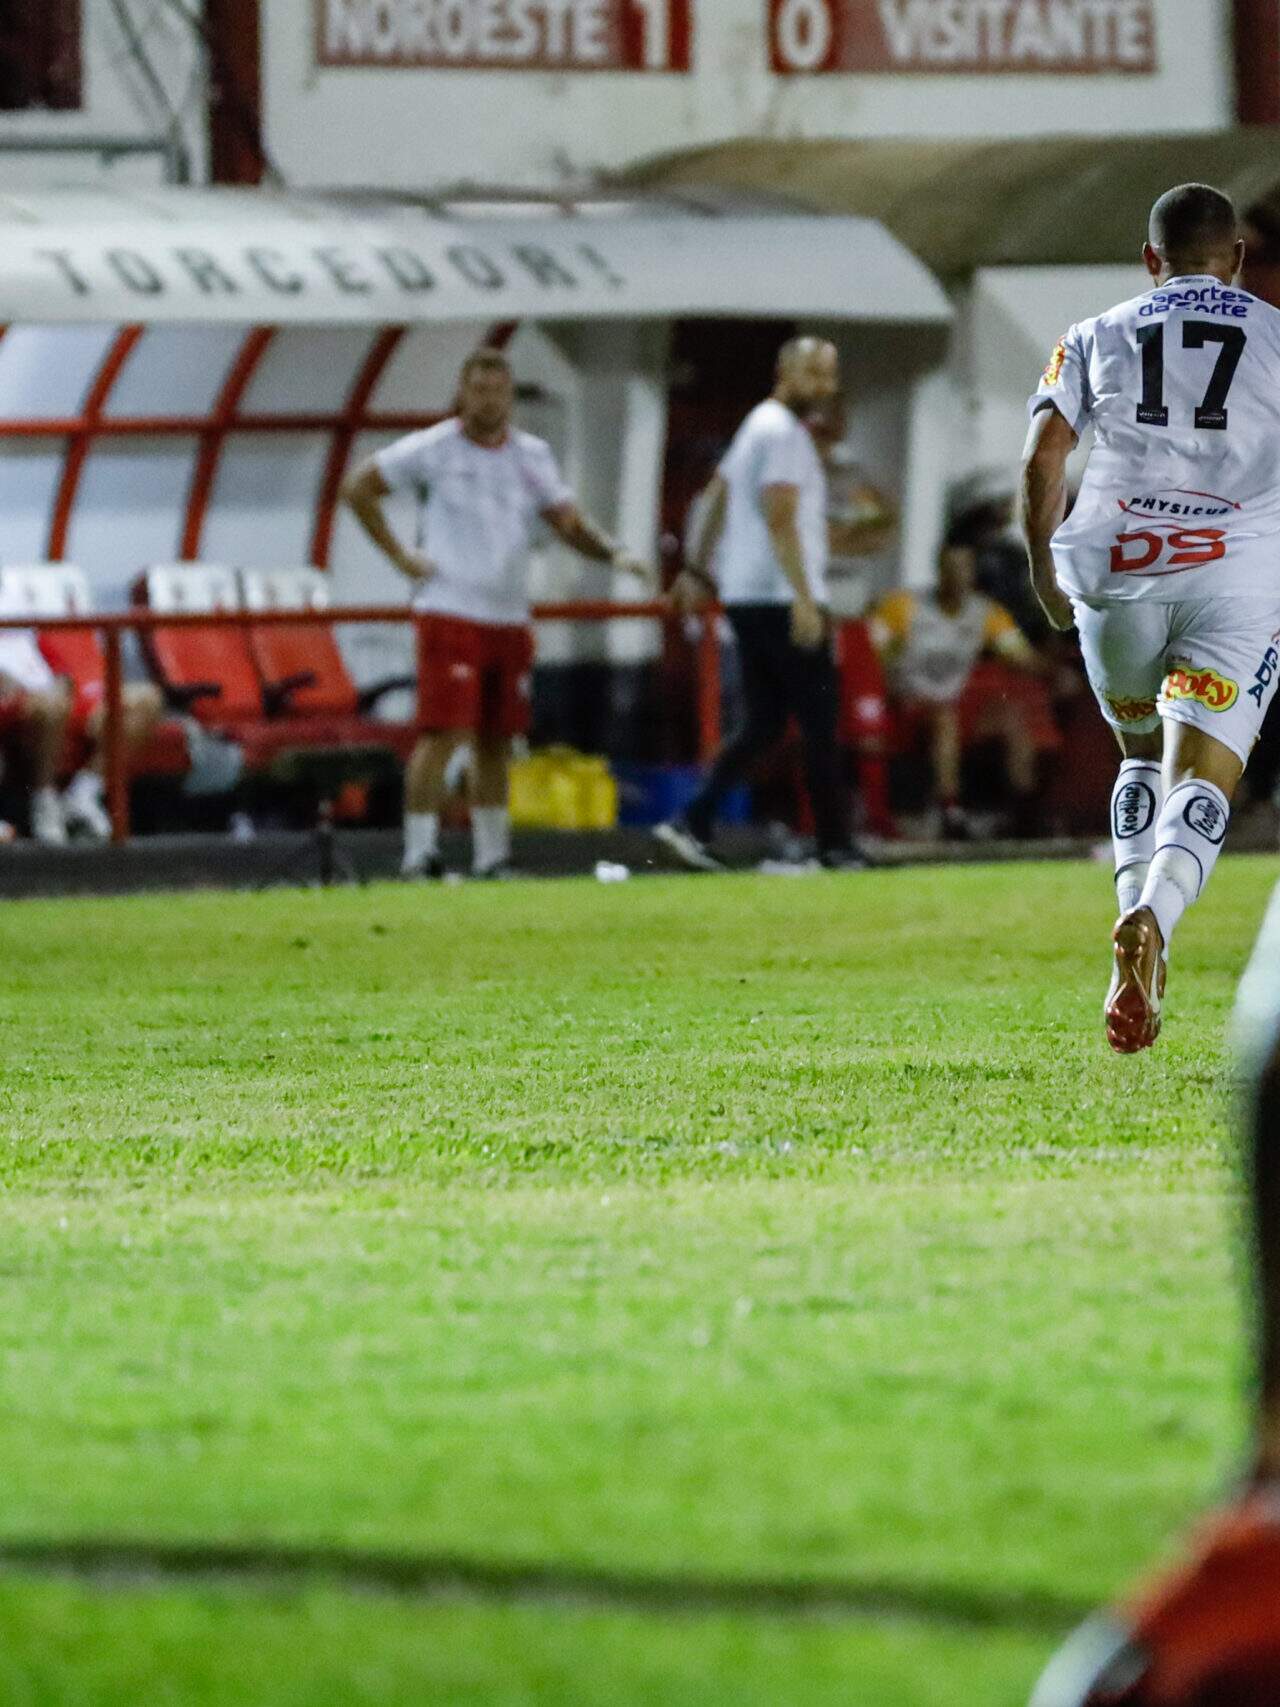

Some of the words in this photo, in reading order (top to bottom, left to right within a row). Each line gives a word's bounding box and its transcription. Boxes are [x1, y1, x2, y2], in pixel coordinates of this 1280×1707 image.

[325, 0, 610, 57] NOROESTE
[634, 0, 672, 68] 1
[776, 0, 832, 67] 0
[878, 0, 1153, 61] VISITANTE
[1136, 320, 1247, 430] 17
[1111, 529, 1227, 573] DS
